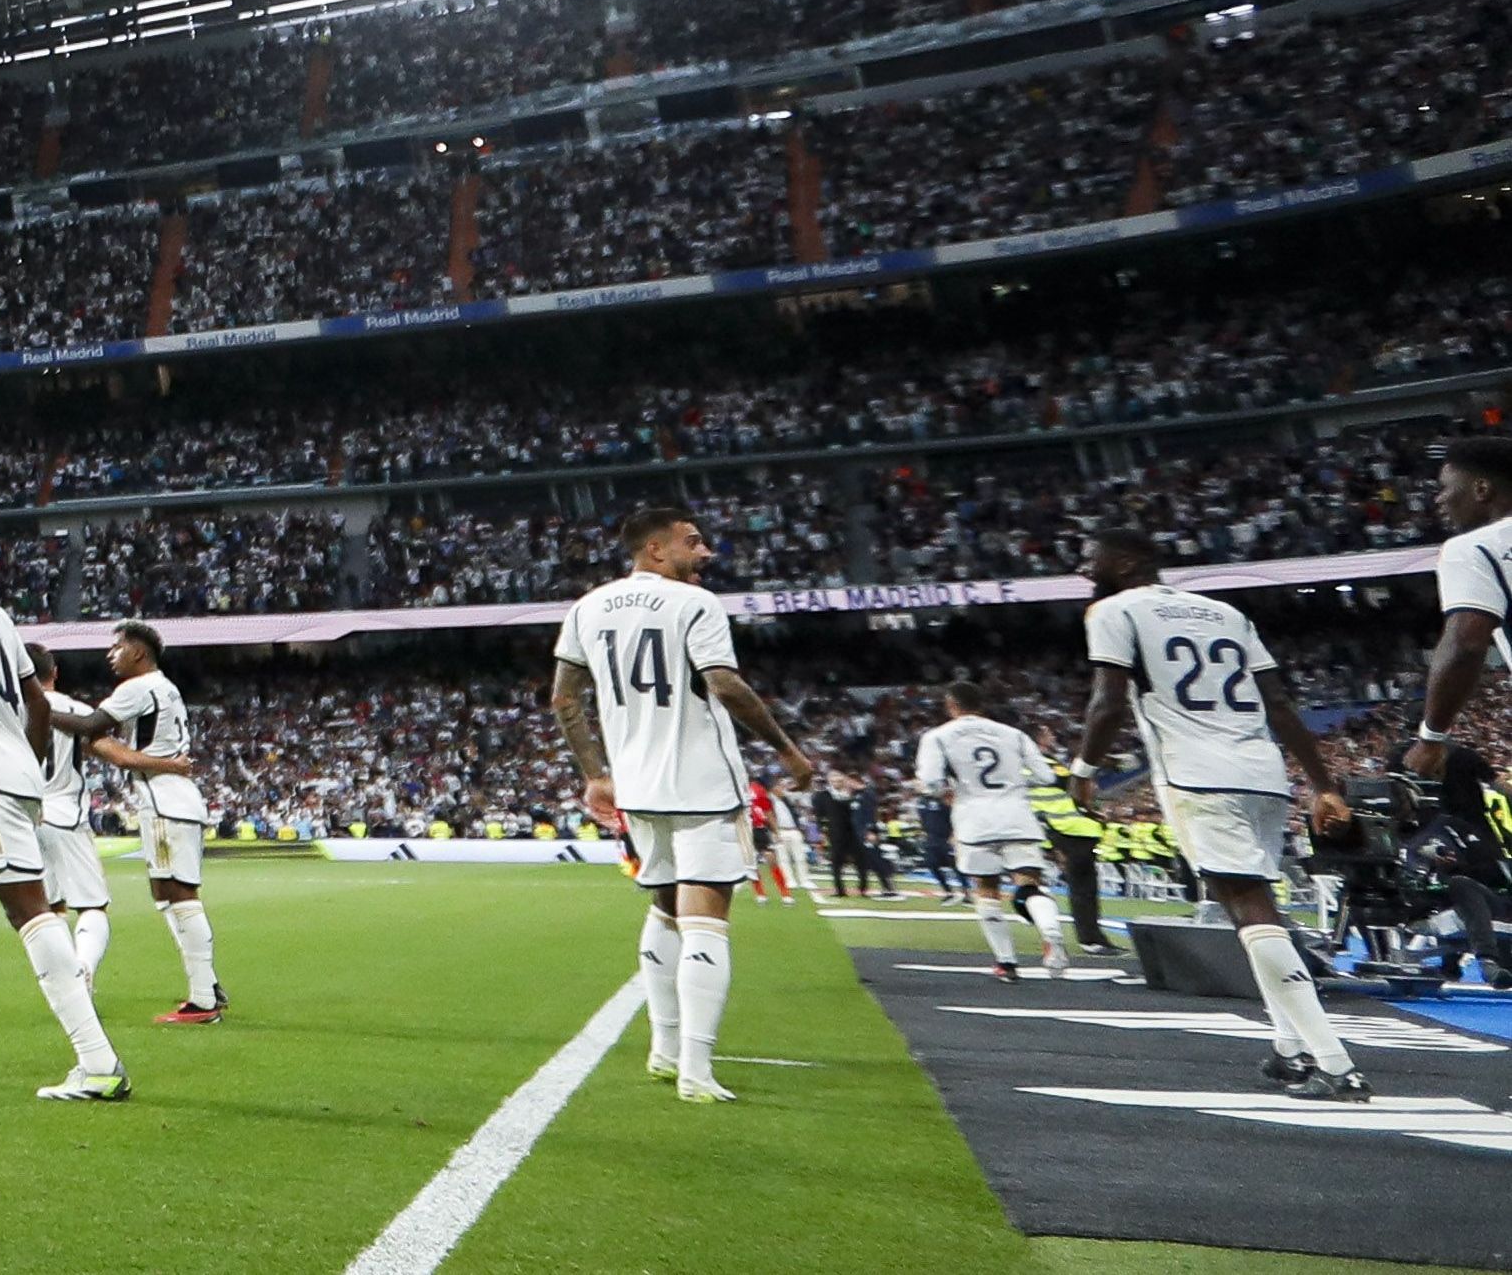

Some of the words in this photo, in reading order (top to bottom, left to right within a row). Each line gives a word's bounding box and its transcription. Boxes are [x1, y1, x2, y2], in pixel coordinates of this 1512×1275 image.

[366, 315, 400, 329] Real
[404, 307, 461, 325] Madrid
[187, 336, 219, 350] Real
[223, 328, 276, 347] Madrid
[23, 352, 53, 365] Real
[56, 346, 103, 362] Madrid
[604, 593, 665, 612] JOSELU
[597, 628, 673, 707] 14
[1165, 636, 1260, 712] 22
[974, 746, 1005, 789] 2
